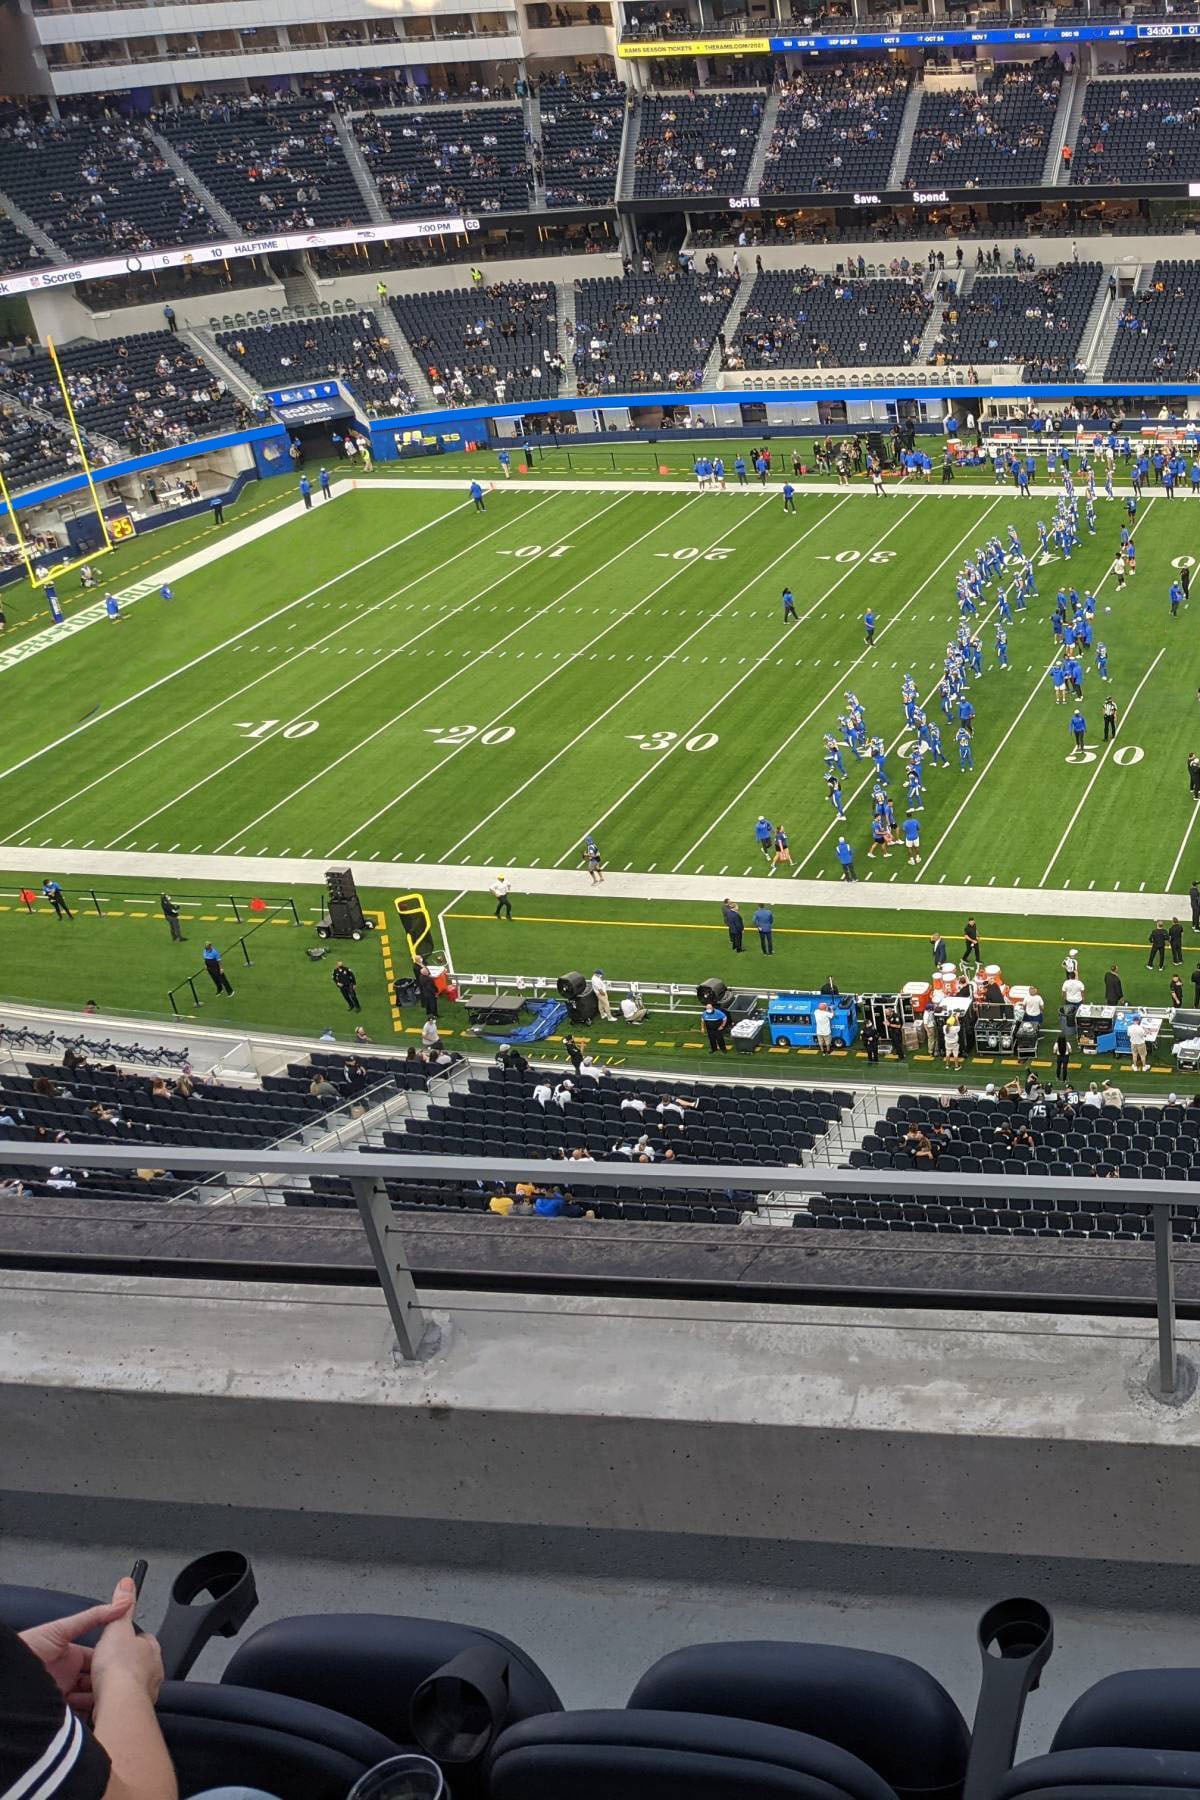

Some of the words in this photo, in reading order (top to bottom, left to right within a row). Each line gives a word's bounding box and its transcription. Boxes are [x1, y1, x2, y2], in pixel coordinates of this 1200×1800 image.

[1146, 27, 1173, 36] 34:00
[729, 198, 749, 208] SoFi
[853, 194, 881, 204] Save.
[913, 192, 949, 203] Spend.
[418, 225, 436, 233] 7:00
[437, 223, 451, 231] PM
[210, 248, 222, 258] 10
[234, 241, 279, 254] HALFTIME
[162, 256, 170, 265] 6
[42, 270, 82, 285] Scores
[111, 518, 132, 538] 25
[240, 719, 319, 739] 10
[430, 724, 517, 745] 20
[639, 731, 720, 752] 30
[1064, 744, 1145, 766] 50
[1067, 1094, 1079, 1104] 30
[1033, 1105, 1047, 1118] 75
